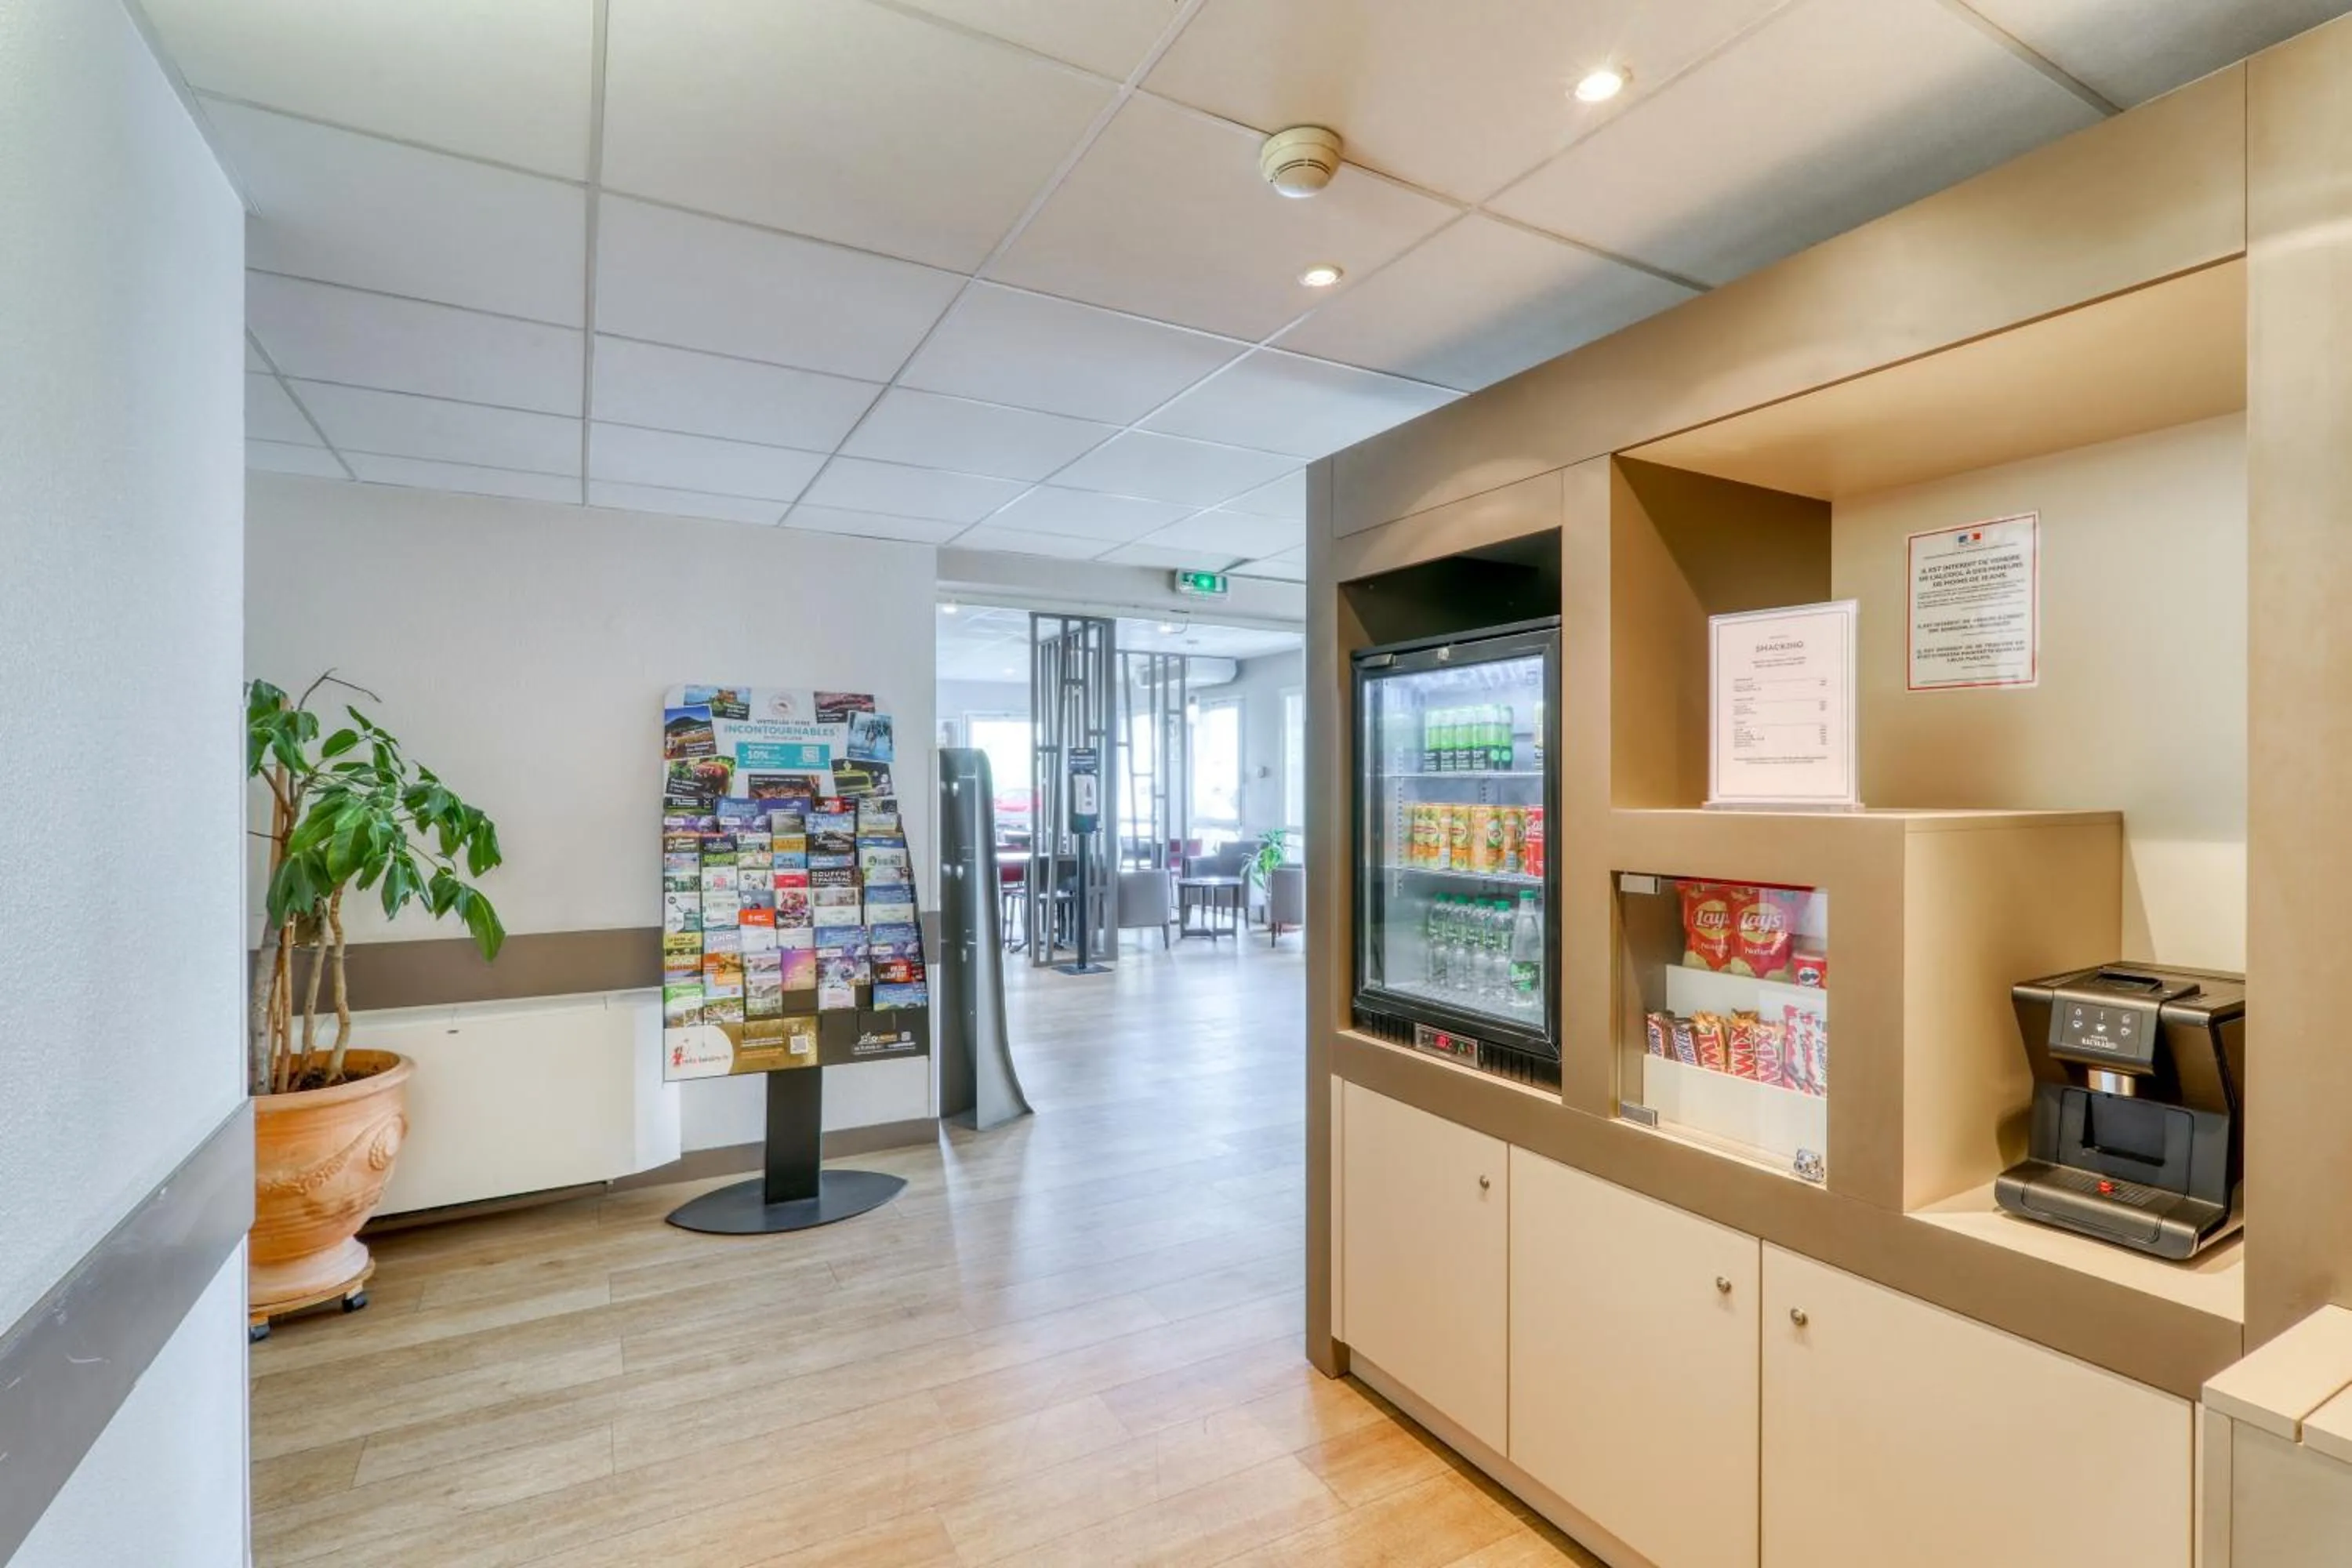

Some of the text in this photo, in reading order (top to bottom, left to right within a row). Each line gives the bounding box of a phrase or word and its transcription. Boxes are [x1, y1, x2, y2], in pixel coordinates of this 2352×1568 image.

[724, 724, 836, 737] INCONTOURNABLES
[1730, 1025, 1759, 1081] WIX
[1755, 1028, 1782, 1085] WIX
